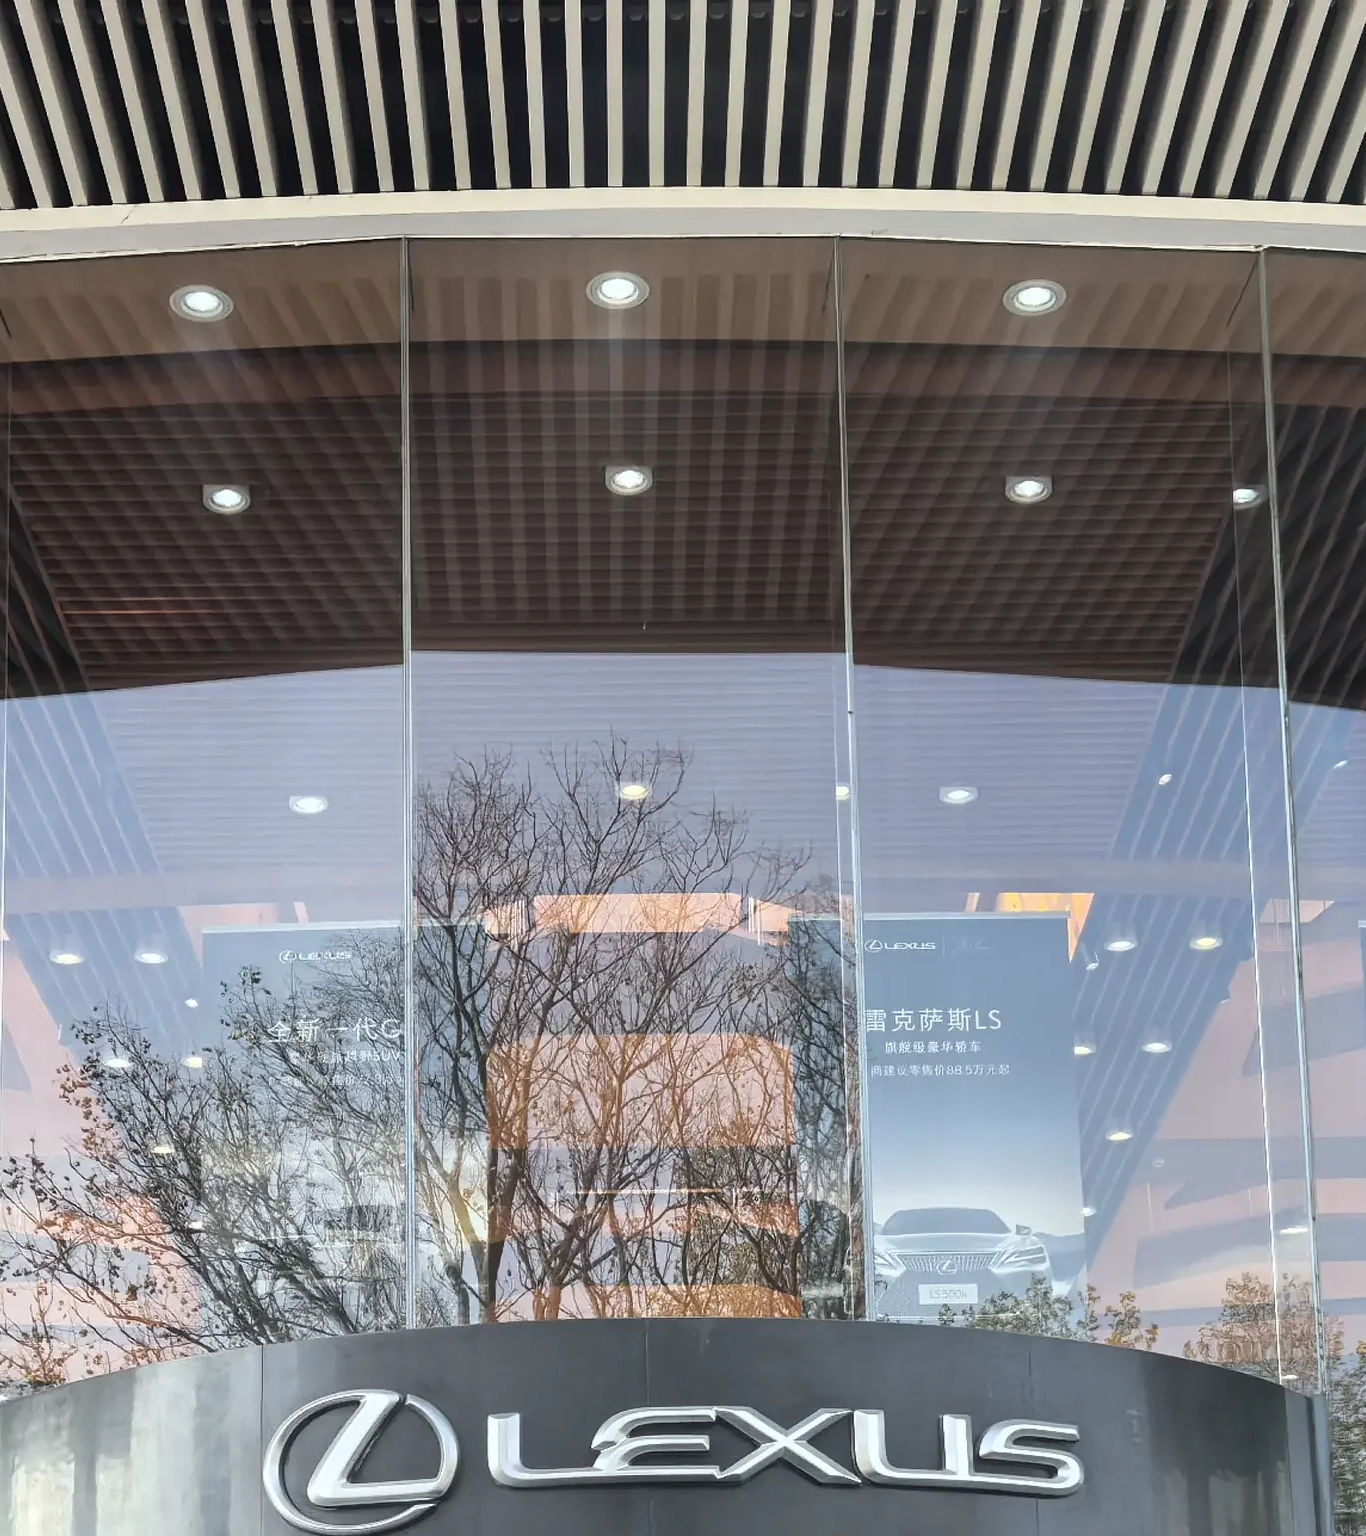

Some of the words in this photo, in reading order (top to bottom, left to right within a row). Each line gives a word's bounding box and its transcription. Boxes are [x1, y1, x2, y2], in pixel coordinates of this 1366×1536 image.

[884, 941, 937, 950] LEXUS
[299, 951, 352, 961] LEXUS
[865, 1007, 1002, 1033] 雷克萨斯LS
[268, 1016, 402, 1044] 全新一代G
[885, 1040, 982, 1054] 旗舰级豪华轿车
[871, 1064, 1010, 1078] 商建议零售价88.5万元起
[487, 1405, 1084, 1497] LEXUS
